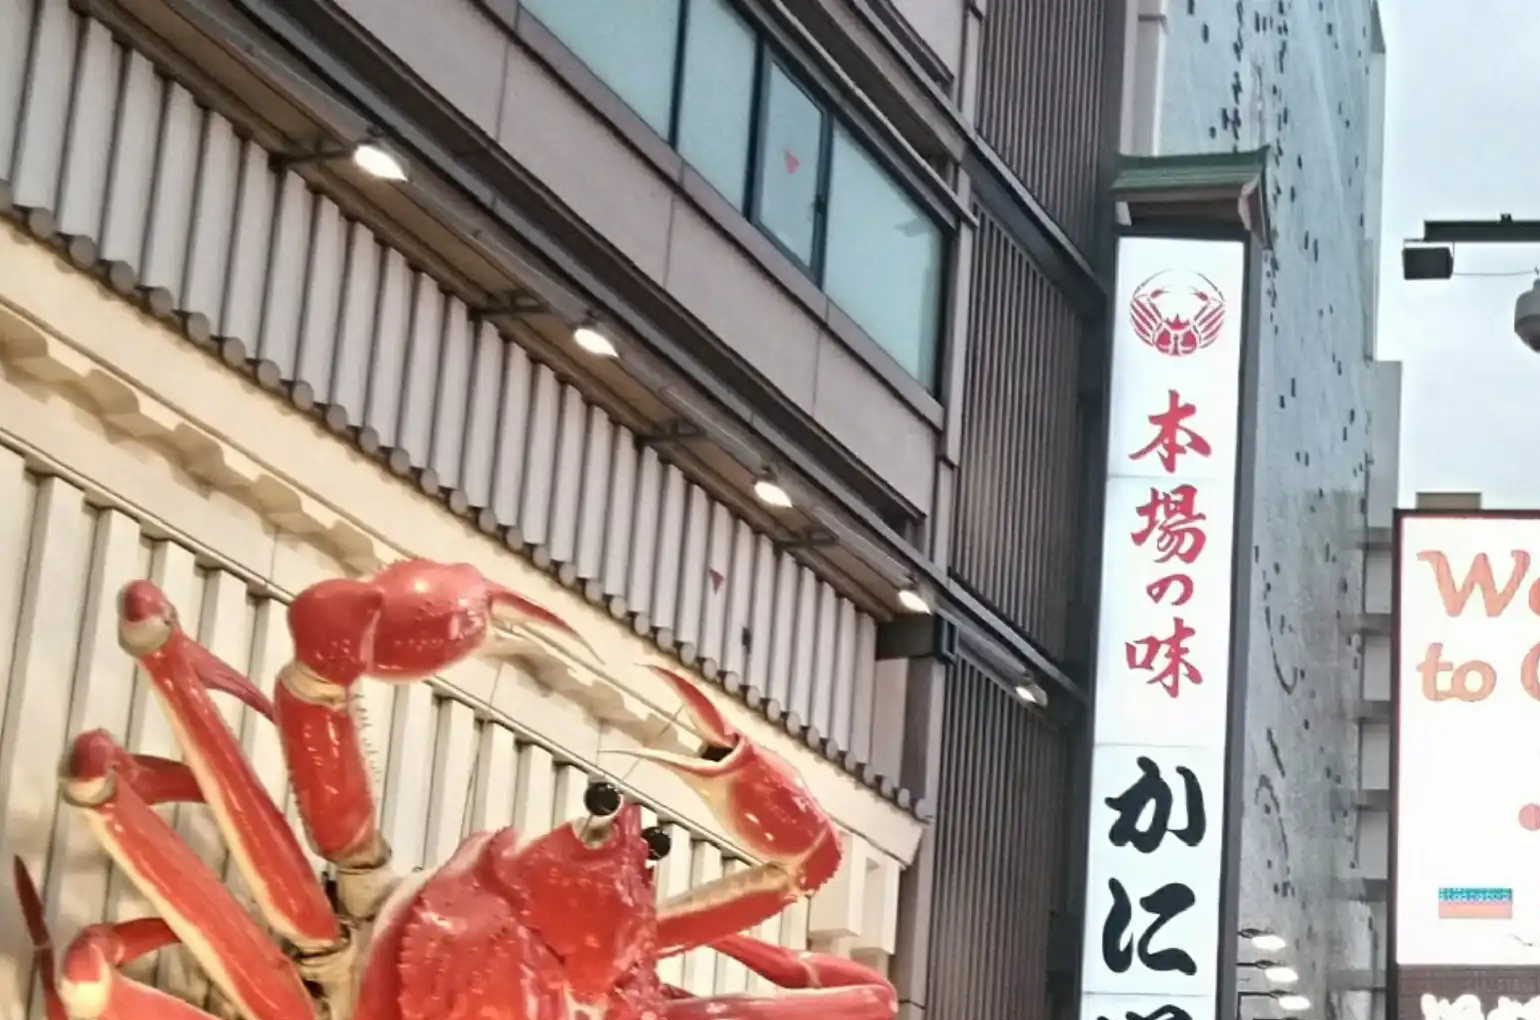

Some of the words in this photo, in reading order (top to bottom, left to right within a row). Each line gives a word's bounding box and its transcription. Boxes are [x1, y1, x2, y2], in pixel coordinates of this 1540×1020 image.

[1125, 389, 1212, 699] 本場の味
[1416, 641, 1497, 703] to
